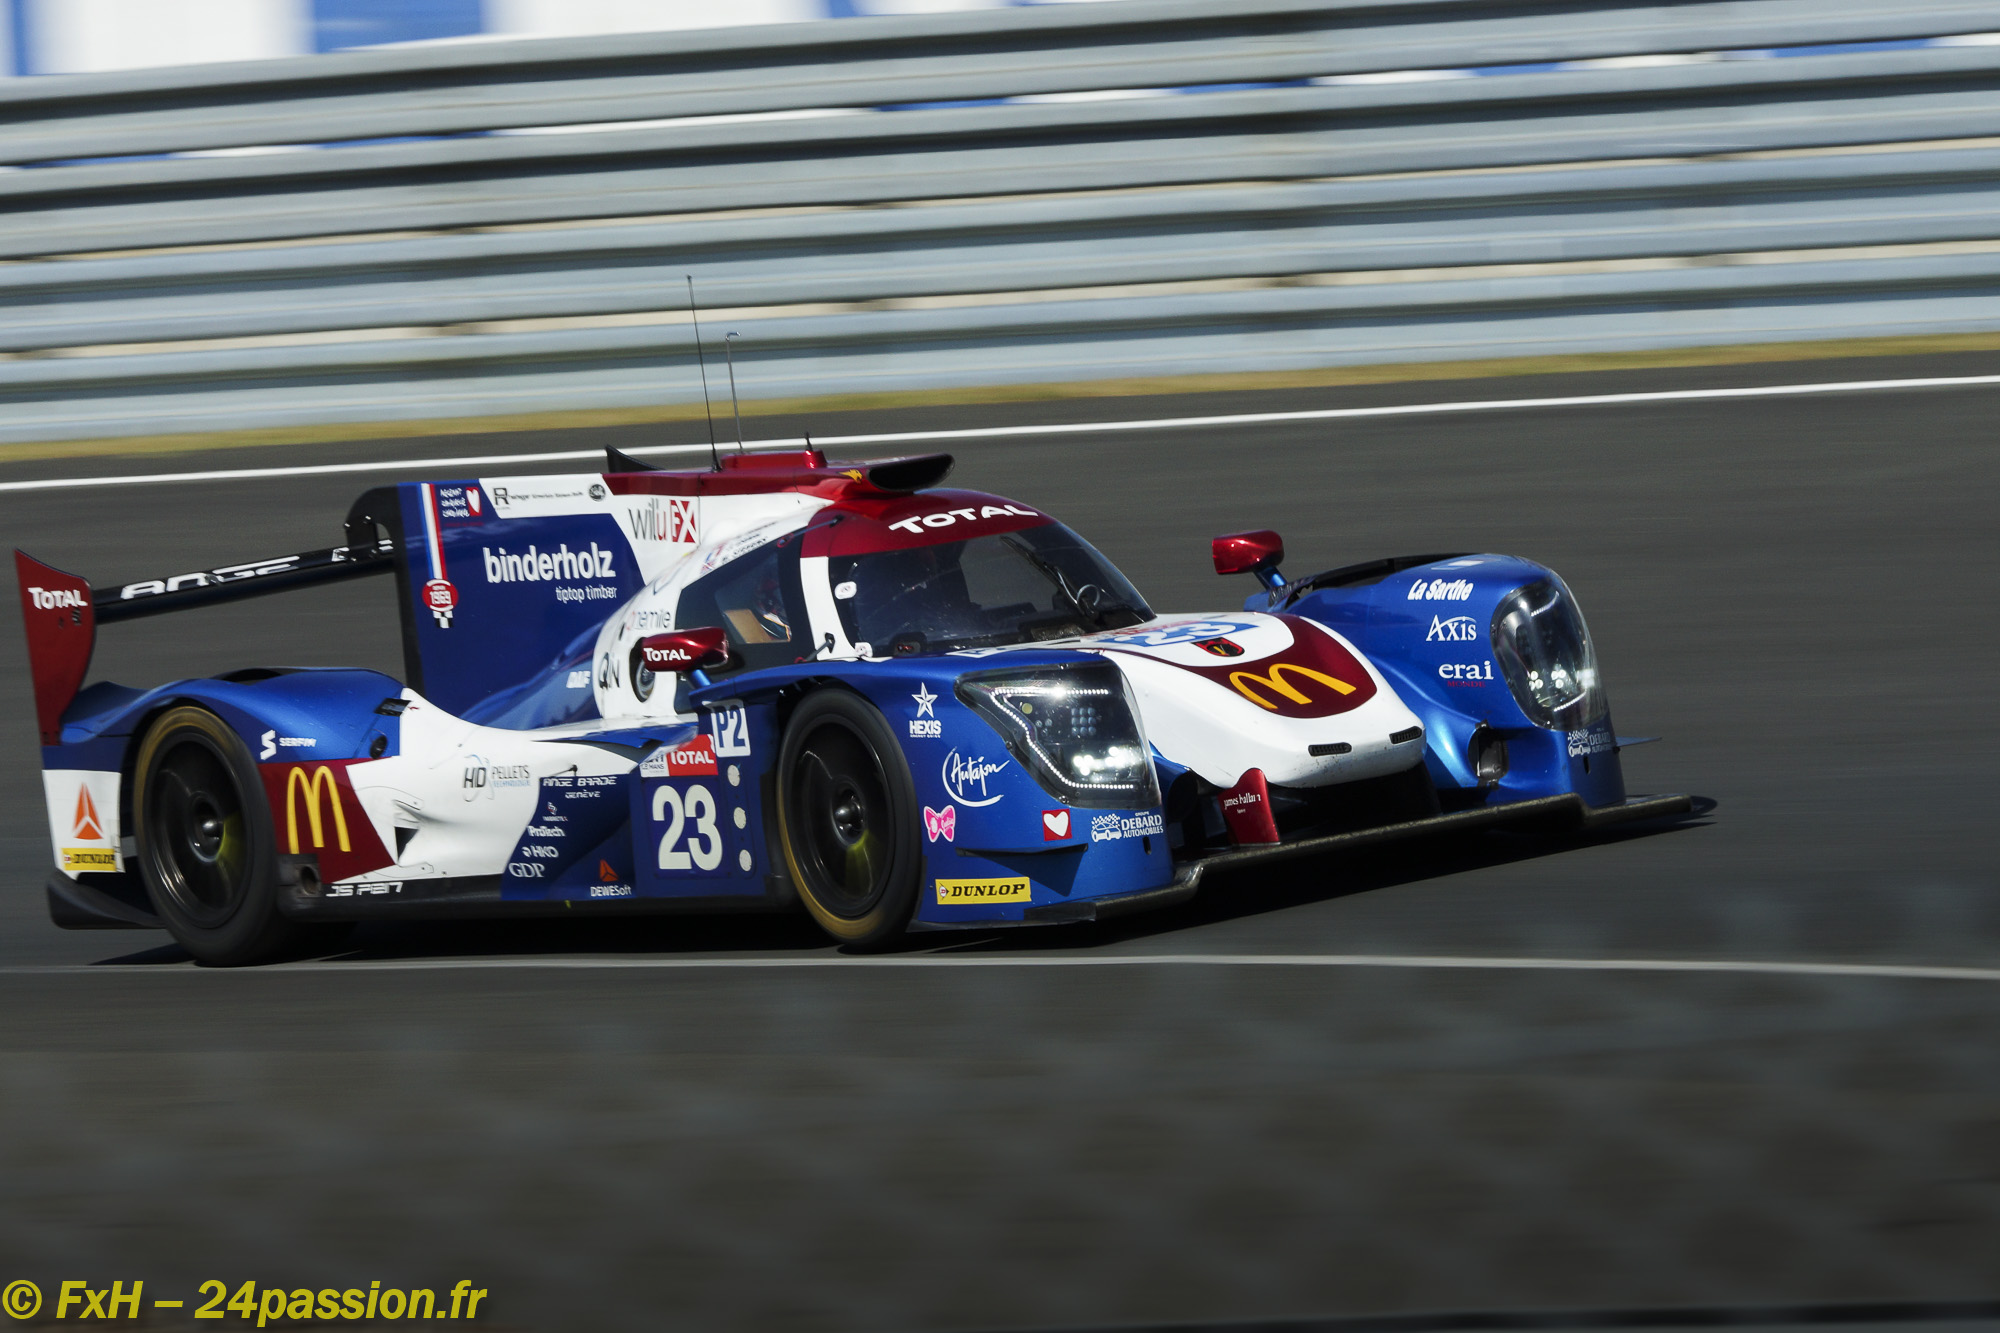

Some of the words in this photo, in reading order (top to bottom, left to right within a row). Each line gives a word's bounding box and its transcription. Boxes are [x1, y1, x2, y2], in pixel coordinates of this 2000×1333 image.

[888, 505, 1038, 534] TOTAL
[483, 541, 616, 583] binderholz
[28, 587, 88, 610] TOTAL
[555, 585, 585, 604] tiptop
[585, 584, 617, 600] timber
[1407, 578, 1428, 601] La
[1425, 578, 1474, 601] Sarthe
[1426, 614, 1477, 642] Axis
[643, 647, 692, 662] TOTAL
[1438, 660, 1494, 680] erai
[715, 703, 747, 748] P2
[909, 720, 942, 735] HEXIS
[279, 737, 317, 748] SERFIM
[463, 767, 487, 788] HD
[491, 765, 530, 780] PELLETS
[653, 785, 723, 871] 23
[1121, 814, 1163, 831] DEBARD
[1123, 826, 1164, 839] AUTOMOBILES
[508, 862, 545, 878] GDP
[590, 884, 632, 897] DEWESoft
[951, 883, 1025, 897] DUNLOP
